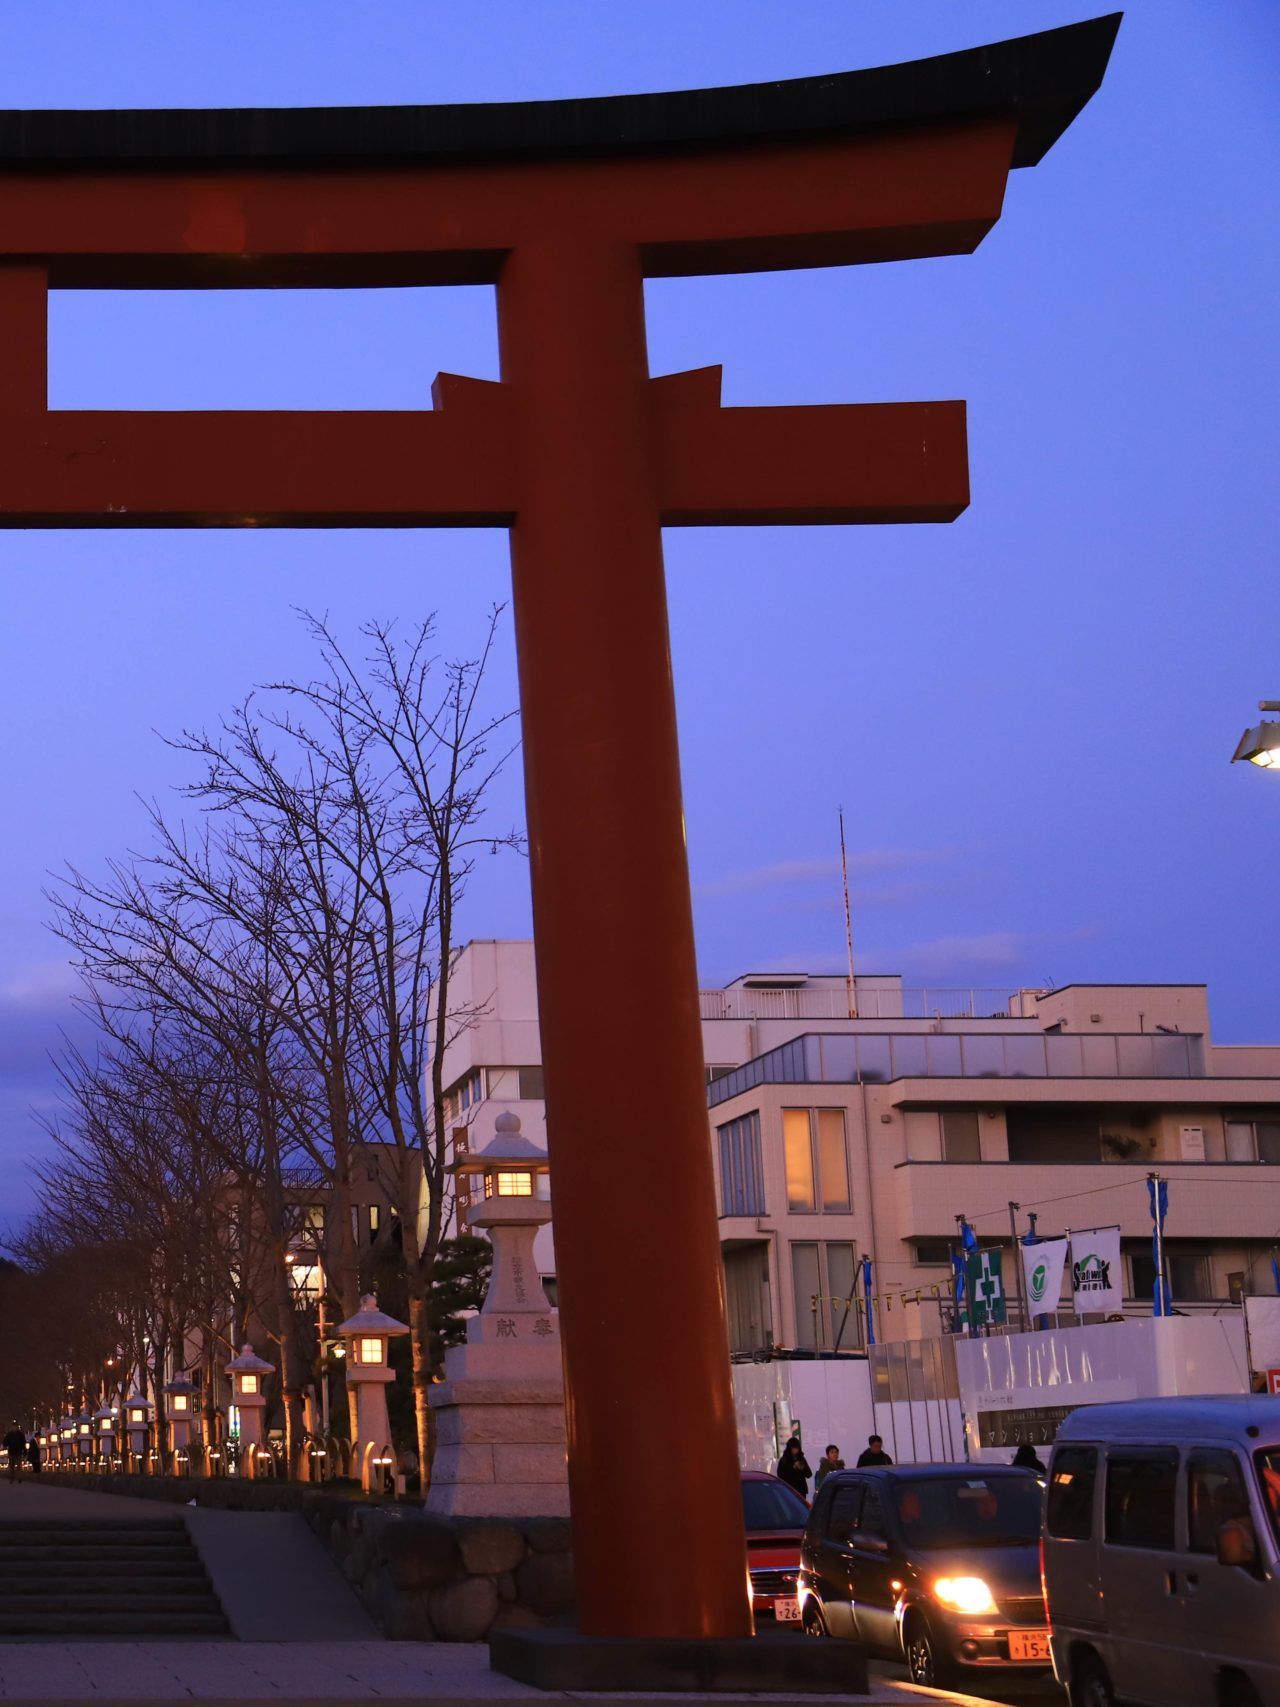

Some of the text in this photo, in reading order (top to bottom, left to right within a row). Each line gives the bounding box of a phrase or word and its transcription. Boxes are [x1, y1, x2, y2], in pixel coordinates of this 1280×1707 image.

[988, 1423, 1061, 1443] マンション
